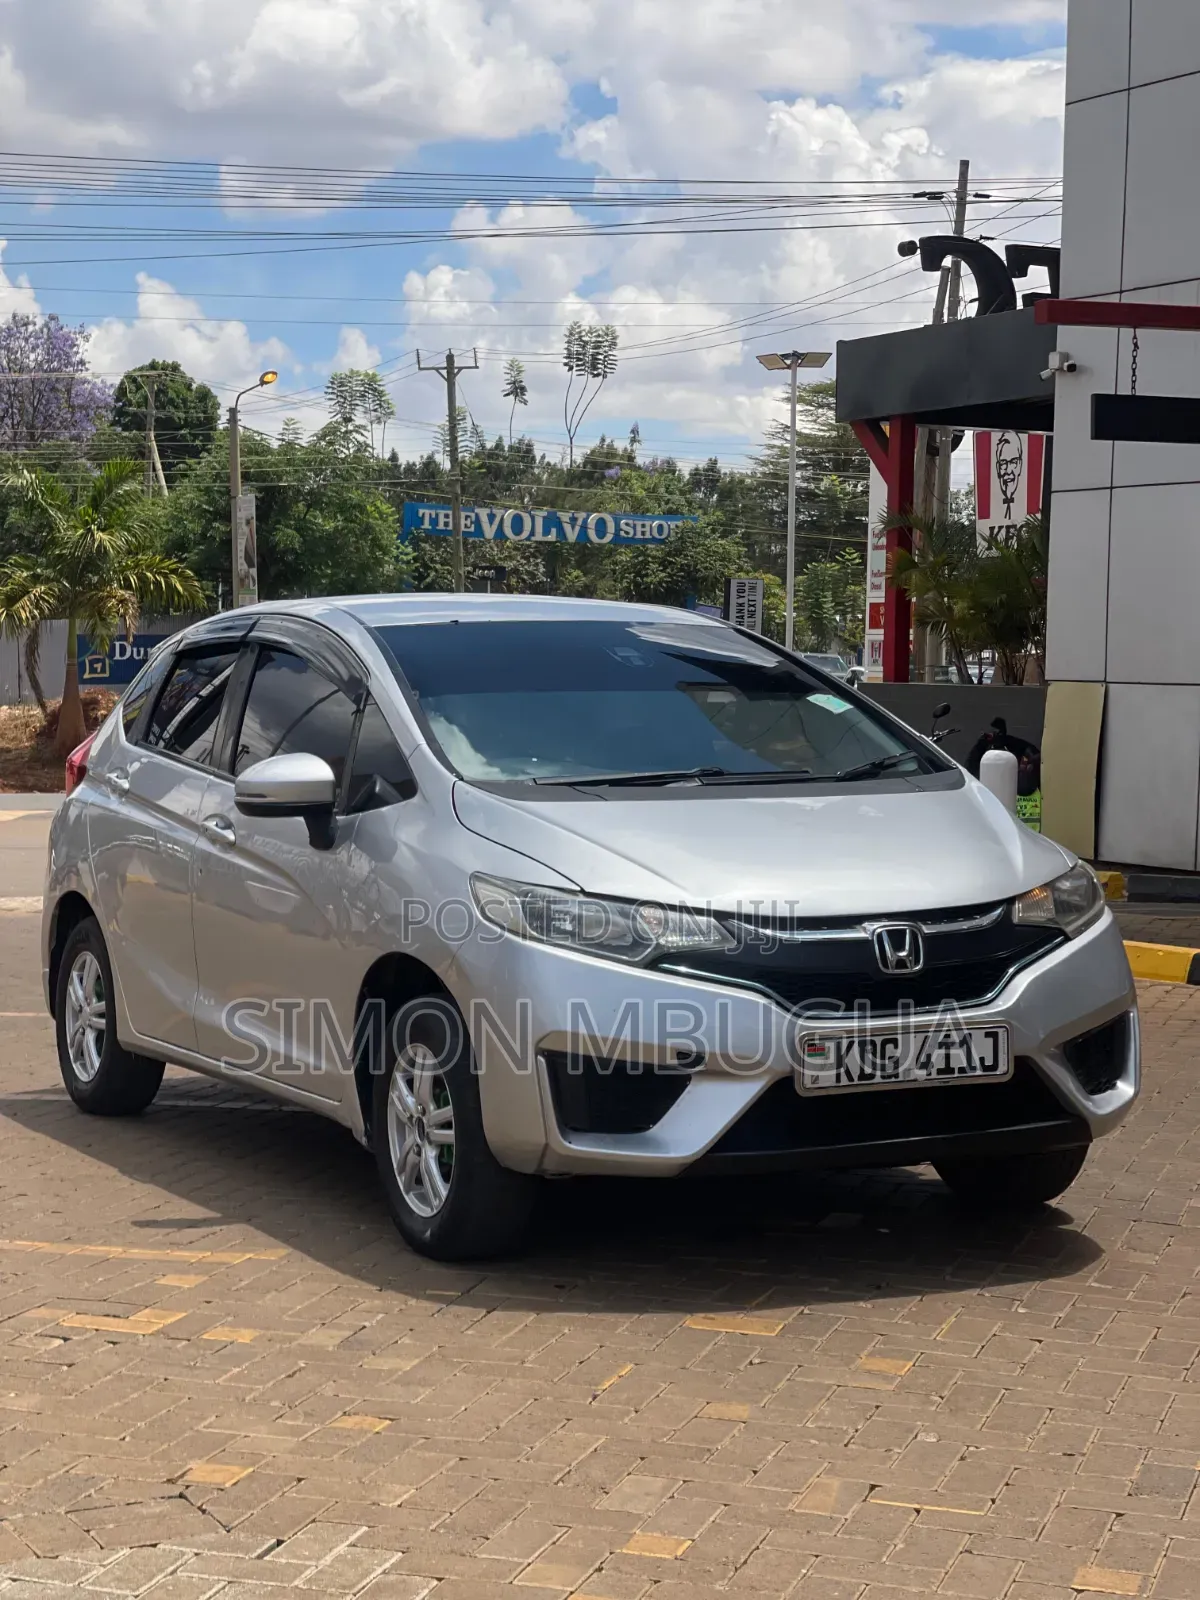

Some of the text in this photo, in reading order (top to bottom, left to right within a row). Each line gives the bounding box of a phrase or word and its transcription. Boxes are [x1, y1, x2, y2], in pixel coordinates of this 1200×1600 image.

[417, 508, 475, 532] THE
[474, 508, 615, 544] VOLVO
[747, 581, 758, 597] TIME
[735, 581, 747, 627] HANK YOU
[747, 598, 757, 619] NEXT
